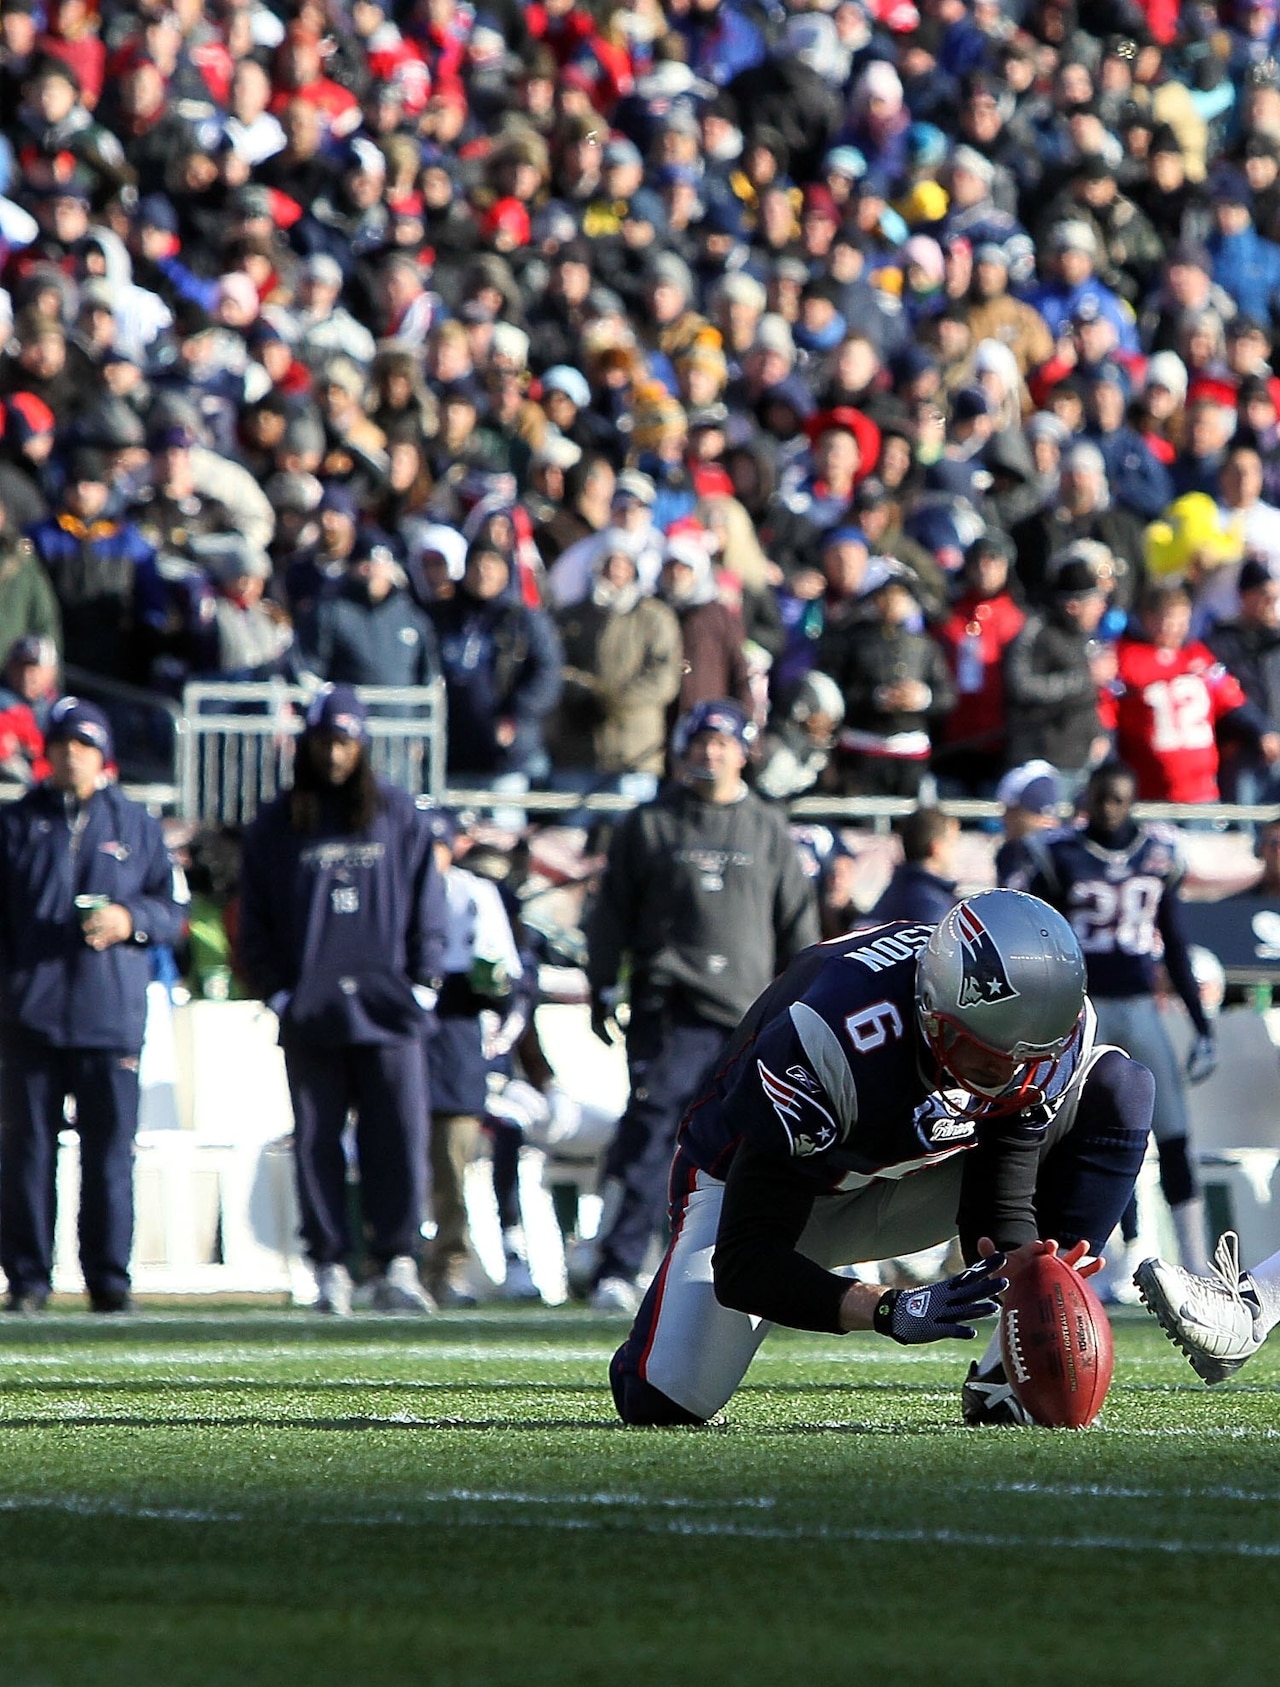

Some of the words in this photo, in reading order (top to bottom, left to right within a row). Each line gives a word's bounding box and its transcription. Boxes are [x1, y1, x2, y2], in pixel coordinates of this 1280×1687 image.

[1143, 674, 1213, 752] 12
[1072, 876, 1165, 956] 28
[846, 1001, 903, 1053] 6
